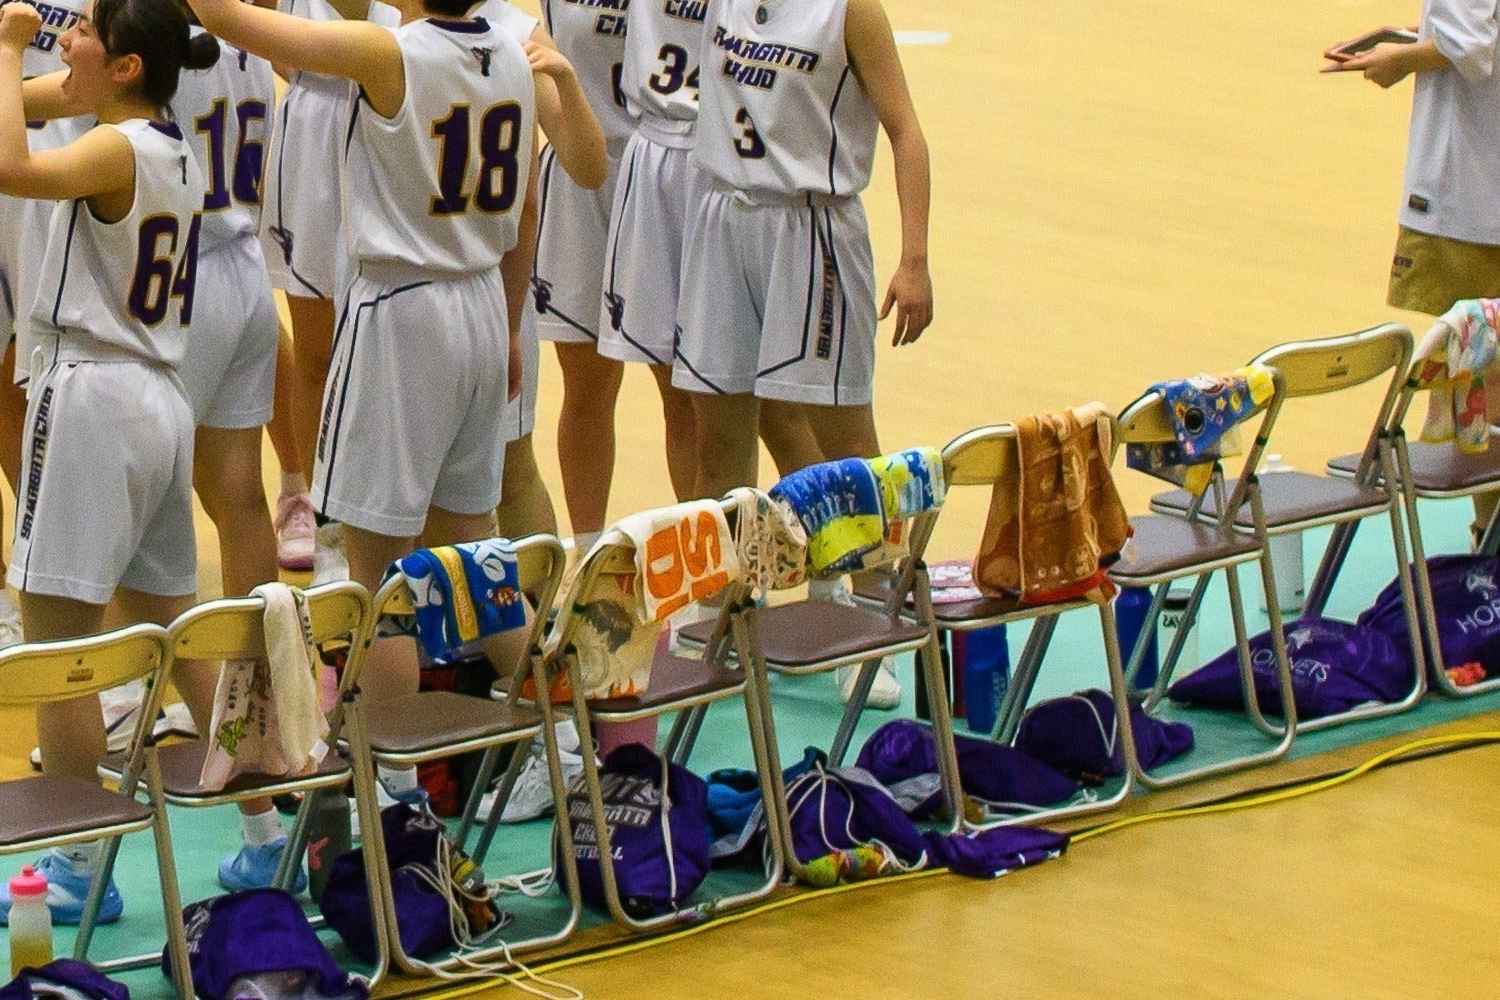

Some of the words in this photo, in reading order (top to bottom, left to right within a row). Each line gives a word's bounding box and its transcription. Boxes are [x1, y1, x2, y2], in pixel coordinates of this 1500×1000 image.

[193, 97, 267, 211] 16
[429, 99, 522, 217] 18
[733, 106, 767, 160] 3
[125, 209, 202, 329] 64
